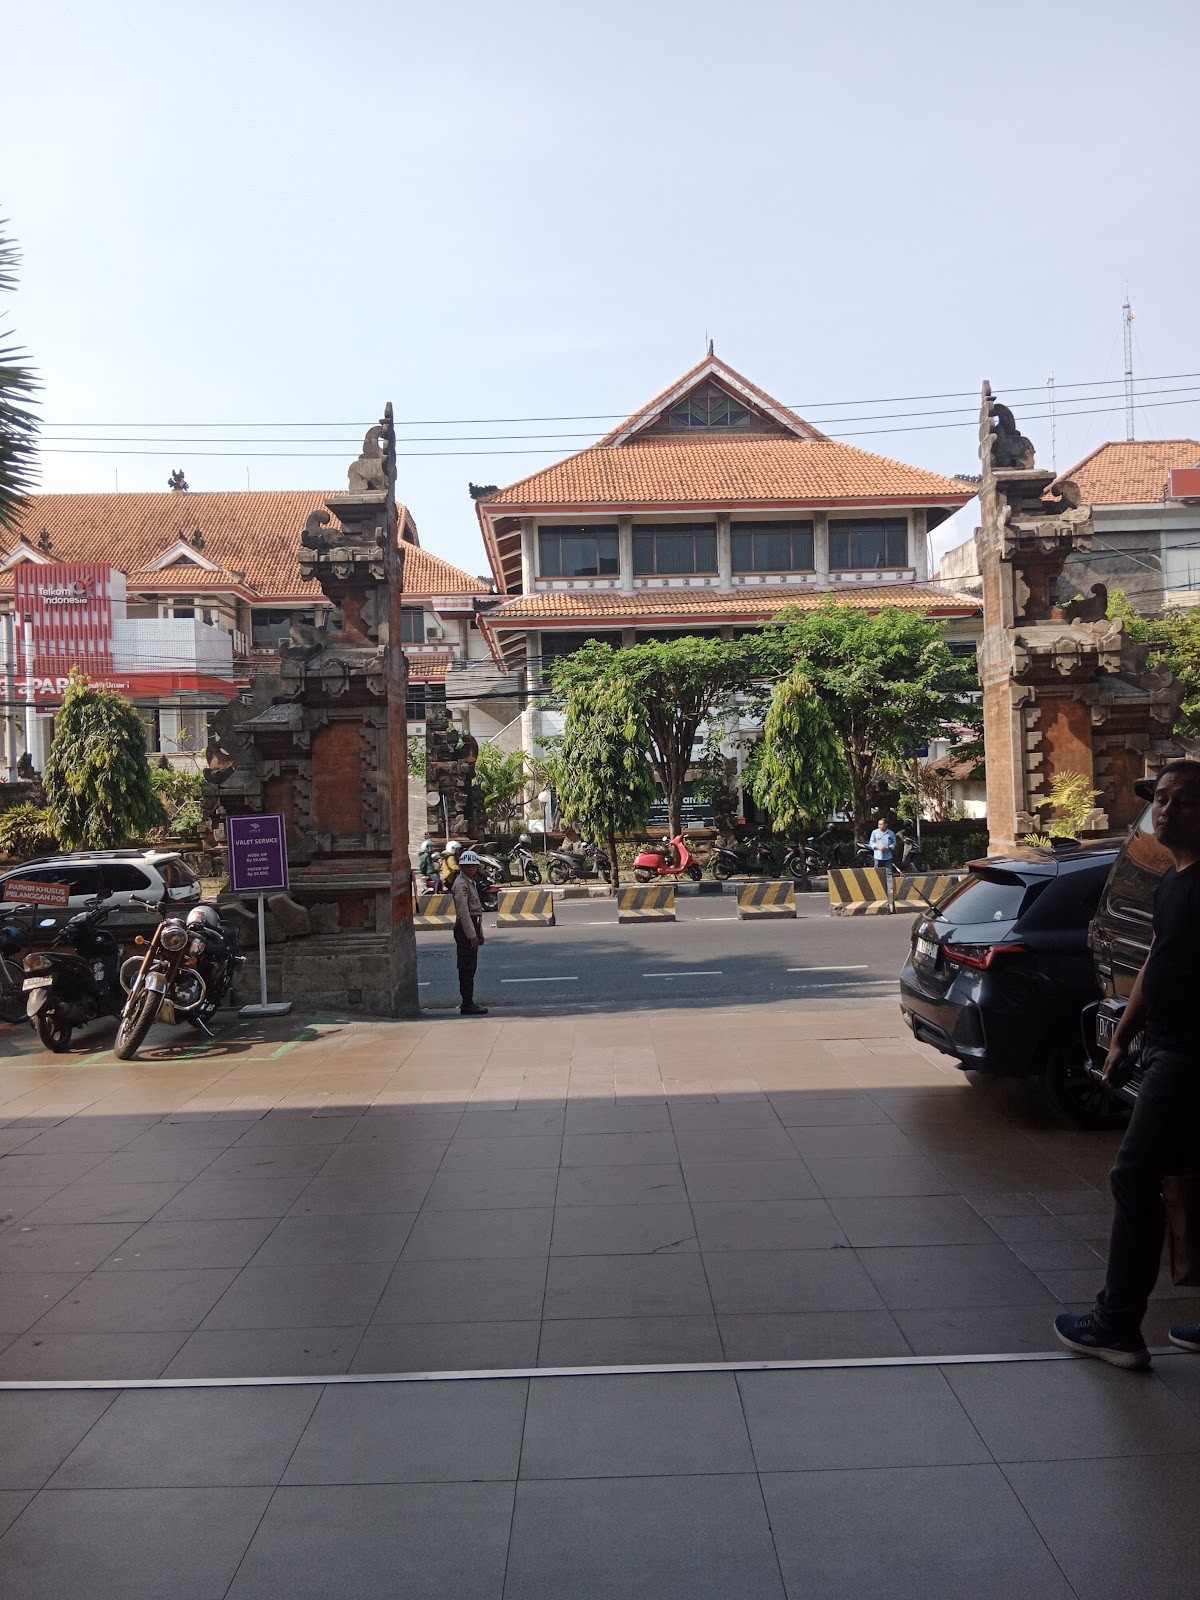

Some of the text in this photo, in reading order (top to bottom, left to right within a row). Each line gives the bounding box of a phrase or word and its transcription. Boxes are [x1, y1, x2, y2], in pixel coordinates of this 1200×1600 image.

[38, 588, 71, 596] Telkom
[254, 837, 278, 845] SERVICE
[8, 883, 66, 896] PARKIR KHUSUS
[5, 890, 66, 903] PELANGGAN POS
